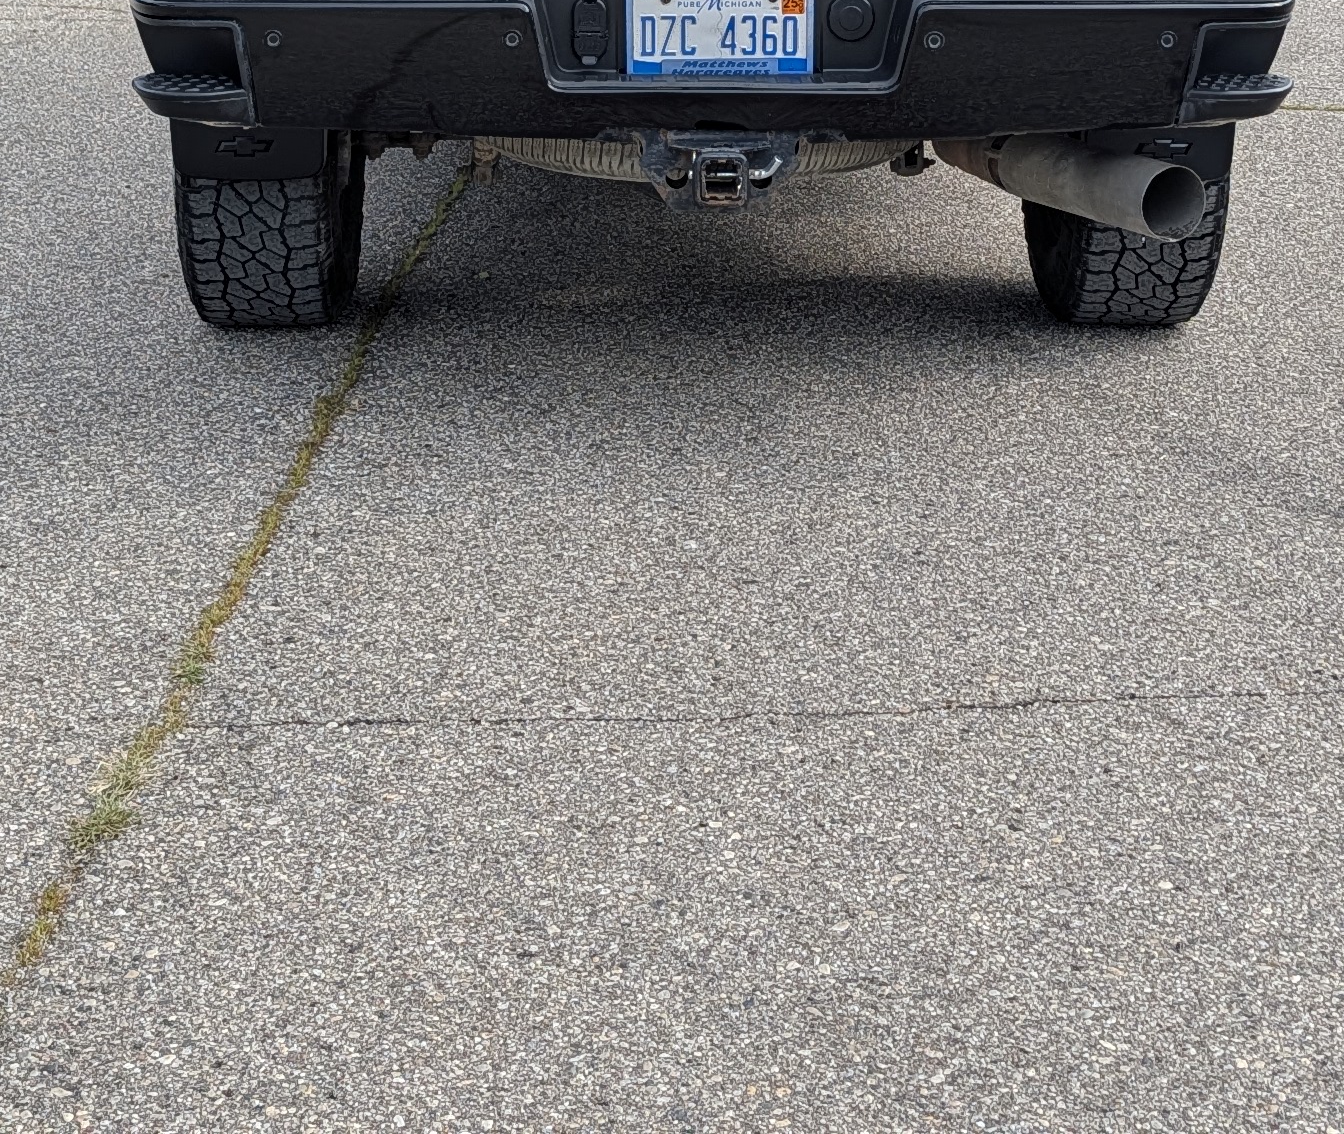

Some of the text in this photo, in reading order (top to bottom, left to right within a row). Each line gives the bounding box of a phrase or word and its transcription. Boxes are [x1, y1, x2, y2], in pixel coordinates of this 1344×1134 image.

[640, 15, 798, 56] DZC 4360
[682, 60, 769, 69] Matthews
